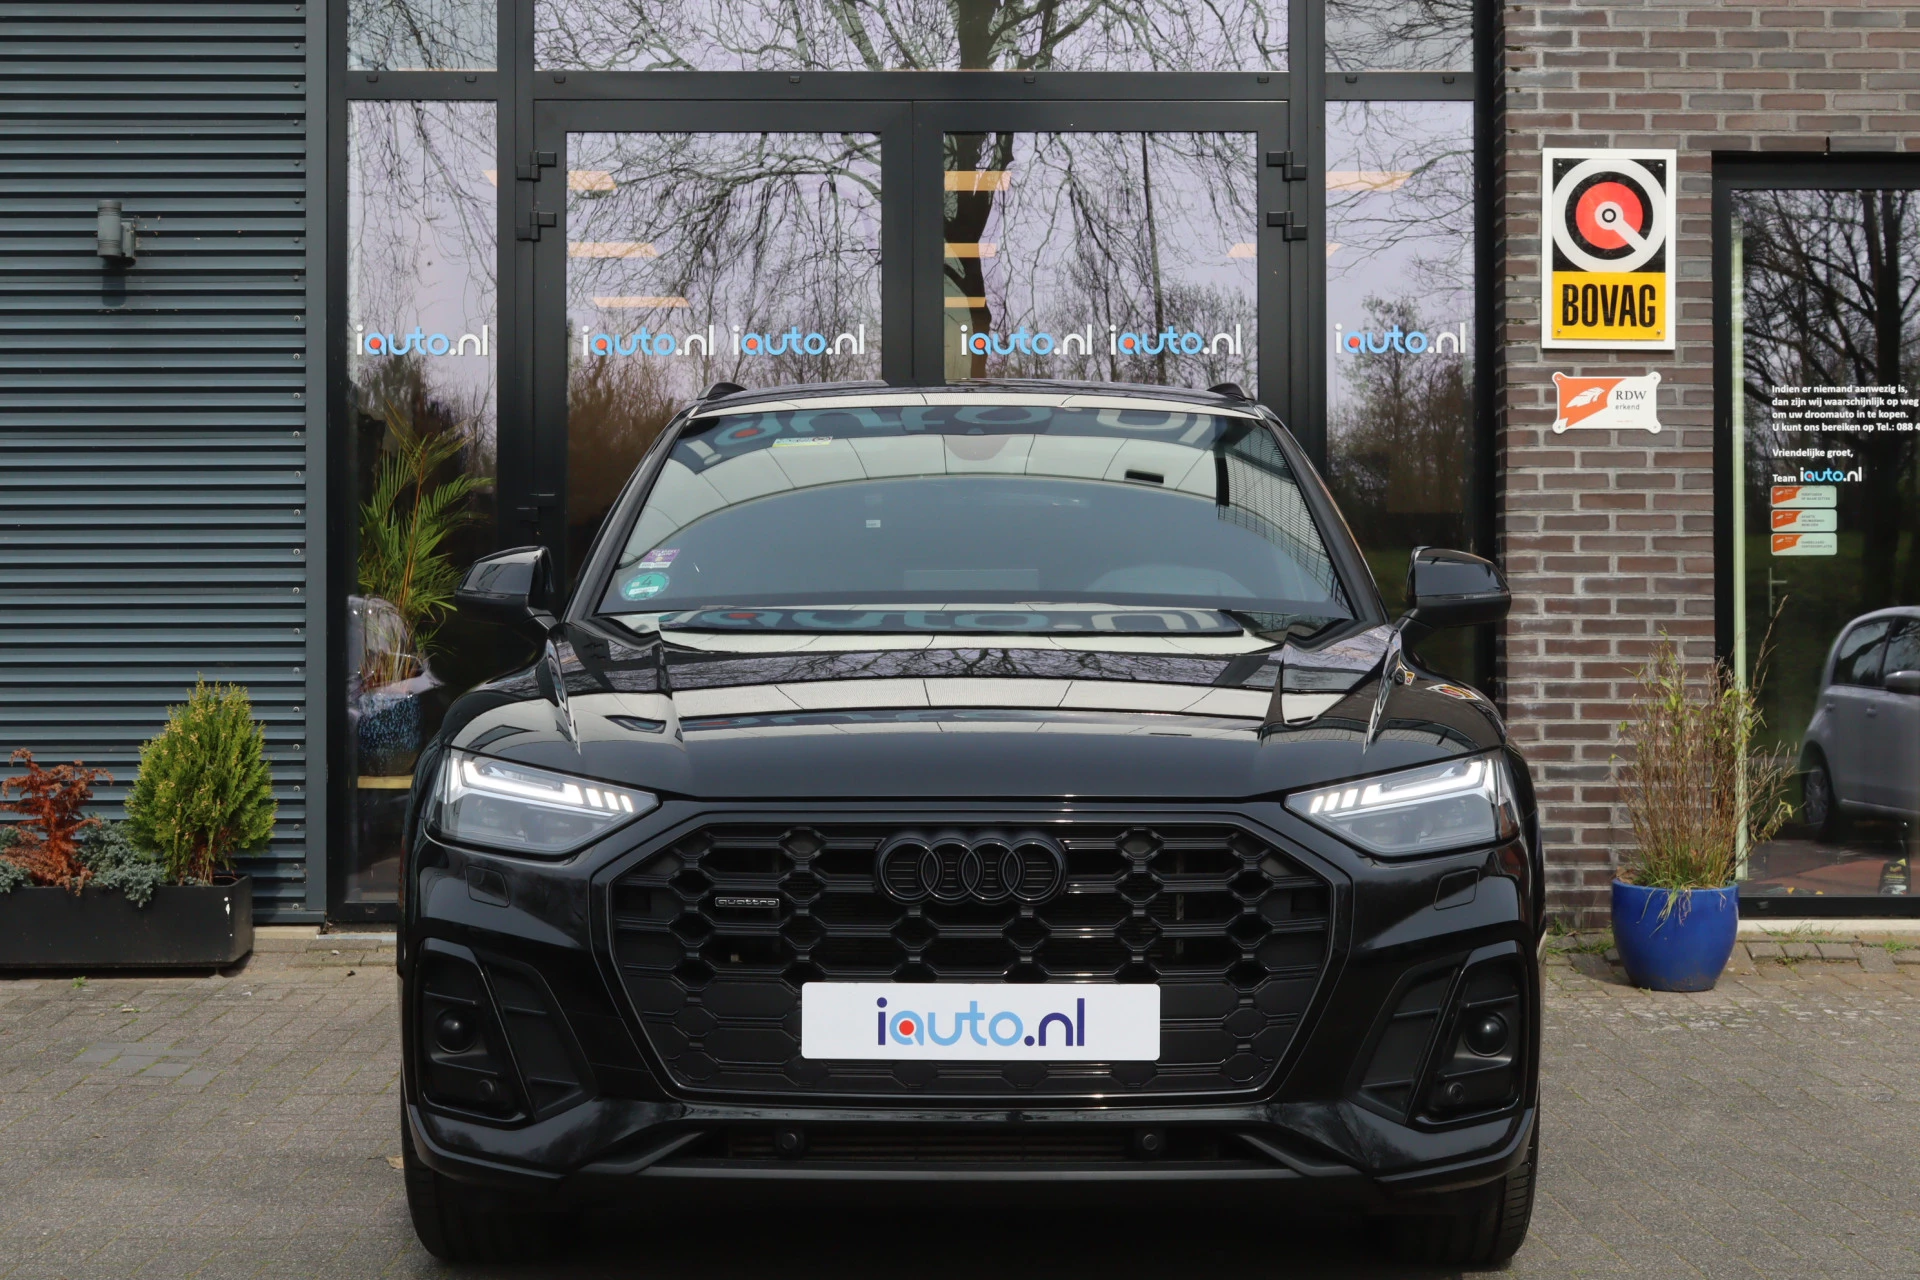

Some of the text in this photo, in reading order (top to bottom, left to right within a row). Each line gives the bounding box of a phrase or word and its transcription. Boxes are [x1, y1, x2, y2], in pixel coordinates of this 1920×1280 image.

[1562, 283, 1656, 328] BOVAG
[356, 324, 489, 357] iauto.nl
[582, 324, 715, 356] iauto.nl
[732, 323, 865, 356] iauto.nl
[960, 323, 1093, 356] iauto.nl
[1110, 323, 1242, 355] iauto.nl
[1335, 322, 1466, 355] iauto.nl
[1616, 390, 1647, 400] RDW
[1772, 384, 1800, 393] Indien
[1813, 384, 1853, 393] niemand
[1854, 385, 1896, 394] aanwezig
[1897, 384, 1908, 394] is,
[1772, 397, 1920, 408] dan zijn wij waarschijnlijk op weg
[1772, 409, 1909, 420] om uw droomauto in te kopen.
[1772, 423, 1780, 431] U
[1781, 422, 1802, 431] kunt
[1821, 422, 1861, 431] bereiken
[1862, 424, 1874, 433] op
[1876, 422, 1895, 431] Tel.:
[1896, 422, 1914, 431] 088
[1772, 448, 1854, 458] Vriendelijke groet,
[1772, 466, 1863, 482] Team iauto.nl
[641, 576, 652, 586] 4
[718, 898, 777, 906] quattro
[876, 996, 1085, 1047] iauto.nl
